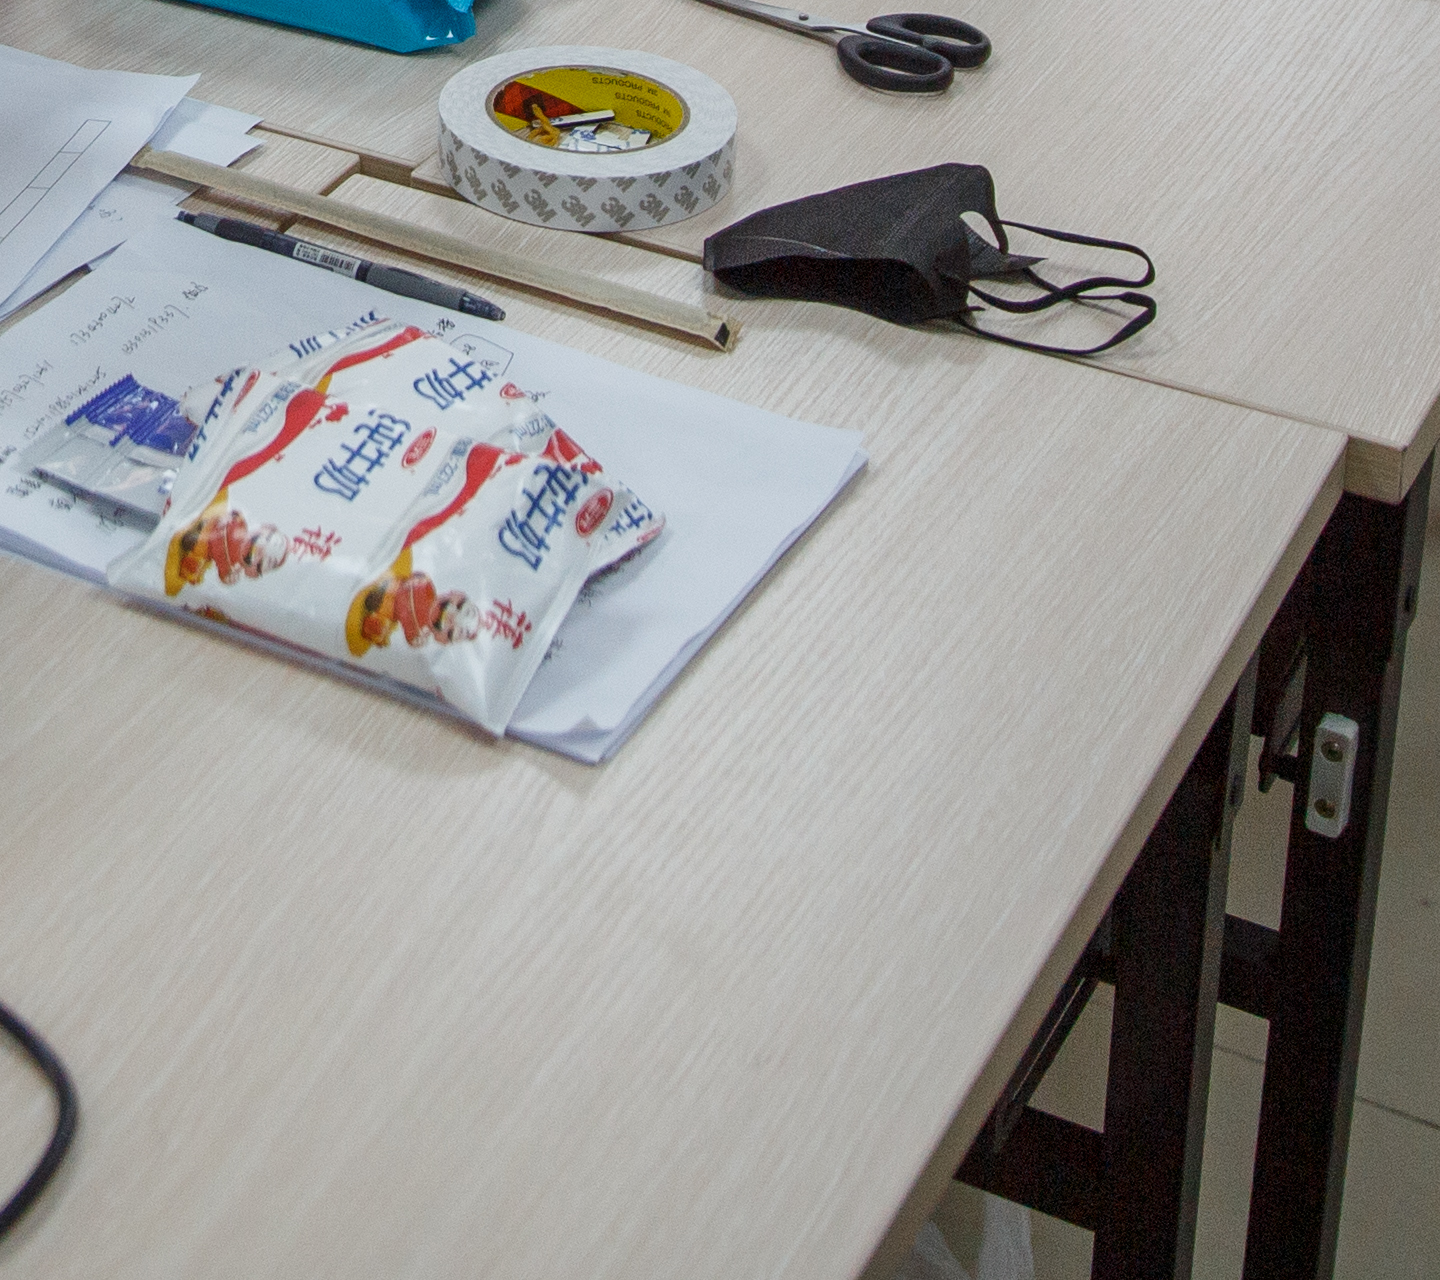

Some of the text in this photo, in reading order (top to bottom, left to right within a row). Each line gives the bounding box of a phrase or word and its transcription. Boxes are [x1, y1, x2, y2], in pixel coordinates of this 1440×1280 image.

[591, 75, 644, 92] PRODUCTS
[490, 178, 520, 215] 3M
[523, 188, 558, 224] 3M
[561, 194, 597, 228] 3M
[600, 196, 636, 228] 3M
[639, 192, 671, 223] 3M
[674, 184, 701, 214] 3M
[412, 356, 499, 412] 牛奶
[313, 408, 411, 503] 纯牛奶
[498, 460, 590, 573] 纯牛奶
